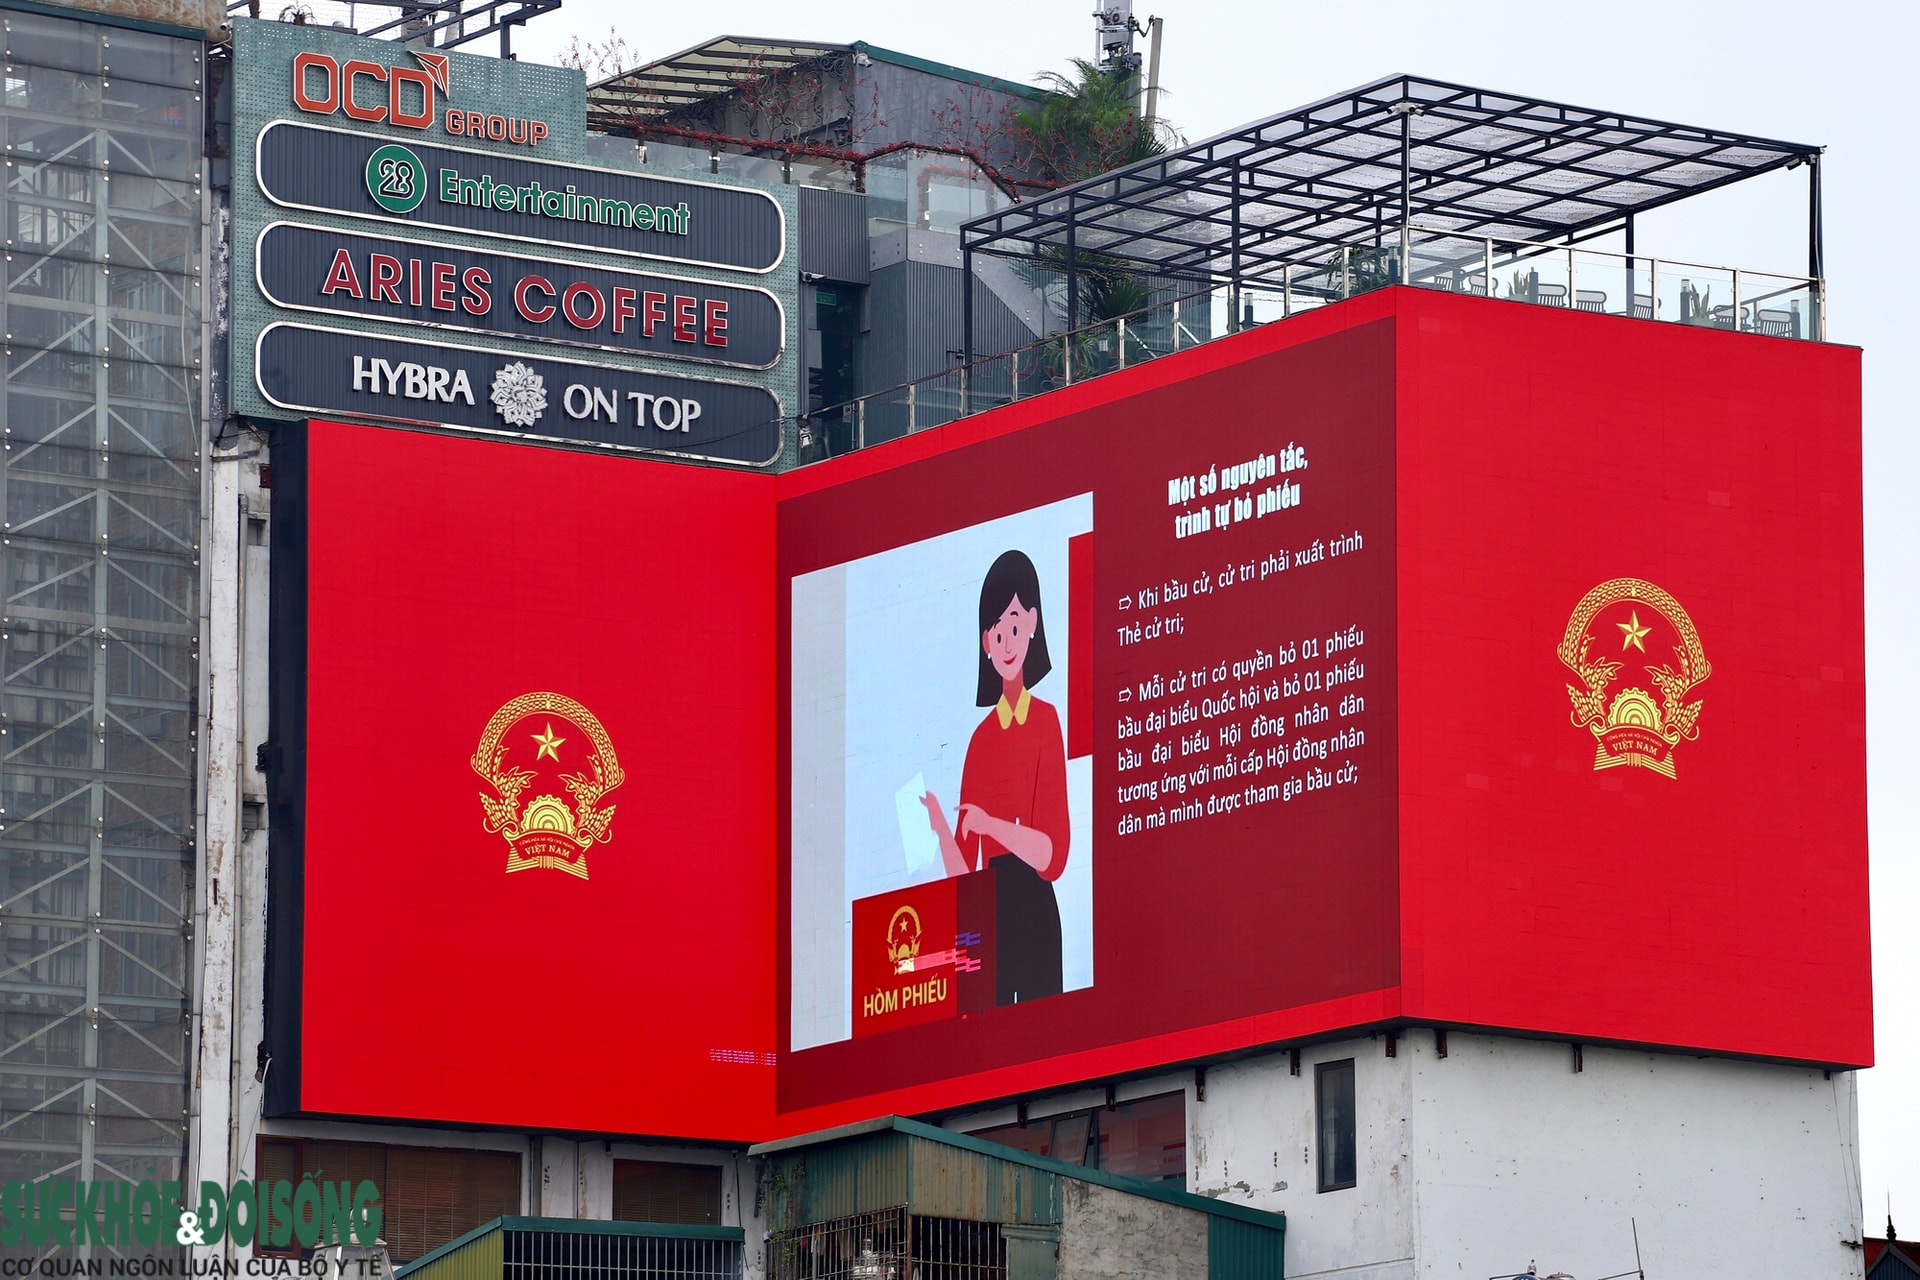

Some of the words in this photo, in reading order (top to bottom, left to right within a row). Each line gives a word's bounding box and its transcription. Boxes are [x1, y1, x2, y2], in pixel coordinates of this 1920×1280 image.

[293, 51, 435, 130] OCD
[445, 109, 548, 146] GROUP
[378, 158, 415, 199] 28
[440, 168, 690, 235] Entertainment
[322, 248, 492, 315] ARIES
[514, 275, 729, 347] COFFEE
[353, 355, 475, 406] HYBRA
[563, 383, 617, 424] ON
[627, 391, 701, 433] TOP
[1168, 476, 1195, 506] Một
[1200, 464, 1217, 496] số
[1221, 453, 1275, 492] nguyên
[1280, 441, 1308, 472] tắc,
[1175, 507, 1210, 538] trình
[1215, 500, 1231, 530] tự
[1234, 492, 1252, 522] bỏ
[1257, 479, 1300, 518] phiếu
[1139, 587, 1158, 609] Khi
[1164, 579, 1187, 602] bầu
[1193, 571, 1213, 594] cử,
[1219, 564, 1235, 587] cử
[1240, 560, 1254, 581] tri
[1261, 550, 1289, 580] phải
[1295, 539, 1324, 567] xuất
[1330, 530, 1362, 557] trình
[1118, 622, 1141, 646] Thẻ
[1145, 616, 1161, 639] cử
[1165, 614, 1183, 634] tri;
[1139, 674, 1163, 701] Mỗi
[1170, 670, 1186, 693] cử
[1191, 667, 1206, 688] tri
[1212, 660, 1226, 682] có
[1233, 650, 1272, 681] quyền
[1280, 641, 1296, 665] bỏ
[1303, 638, 1319, 659] 01
[1326, 624, 1363, 658] phiếu
[1118, 716, 1141, 739] bầu
[1146, 711, 1165, 733] đại
[1170, 700, 1197, 726] biểu
[1202, 690, 1235, 718] Quốc
[1240, 685, 1259, 709] hội
[1264, 683, 1278, 701] và
[1284, 673, 1300, 697] bỏ
[1305, 671, 1321, 691] 01
[1326, 657, 1363, 691] phiếu
[1119, 748, 1141, 771] bầu
[1152, 741, 1171, 764] đại
[1182, 730, 1209, 755] biểu
[1220, 723, 1240, 747] Hội
[1251, 715, 1284, 738] đồng
[1295, 703, 1328, 727] nhân
[1340, 694, 1364, 716] dân
[1118, 781, 1157, 803] tương
[1162, 773, 1186, 793] ứng
[1190, 764, 1209, 786] với
[1214, 753, 1236, 780] mỗi
[1241, 749, 1263, 775] cấp
[1267, 744, 1288, 768] Hội
[1293, 737, 1327, 761] đồng
[1331, 727, 1364, 752] nhân
[1636, 741, 1657, 756] NAM
[1118, 814, 1141, 835] dân
[1147, 807, 1165, 829] mà
[1170, 799, 1202, 823] mình
[1207, 794, 1241, 815] được
[1244, 785, 1278, 805] tham
[1283, 776, 1302, 801] gia
[1307, 767, 1331, 791] bầu
[1337, 760, 1357, 784] cử;
[549, 845, 570, 858] NAM
[863, 987, 898, 1018] HÒM
[902, 973, 947, 1008] PHIẾU
